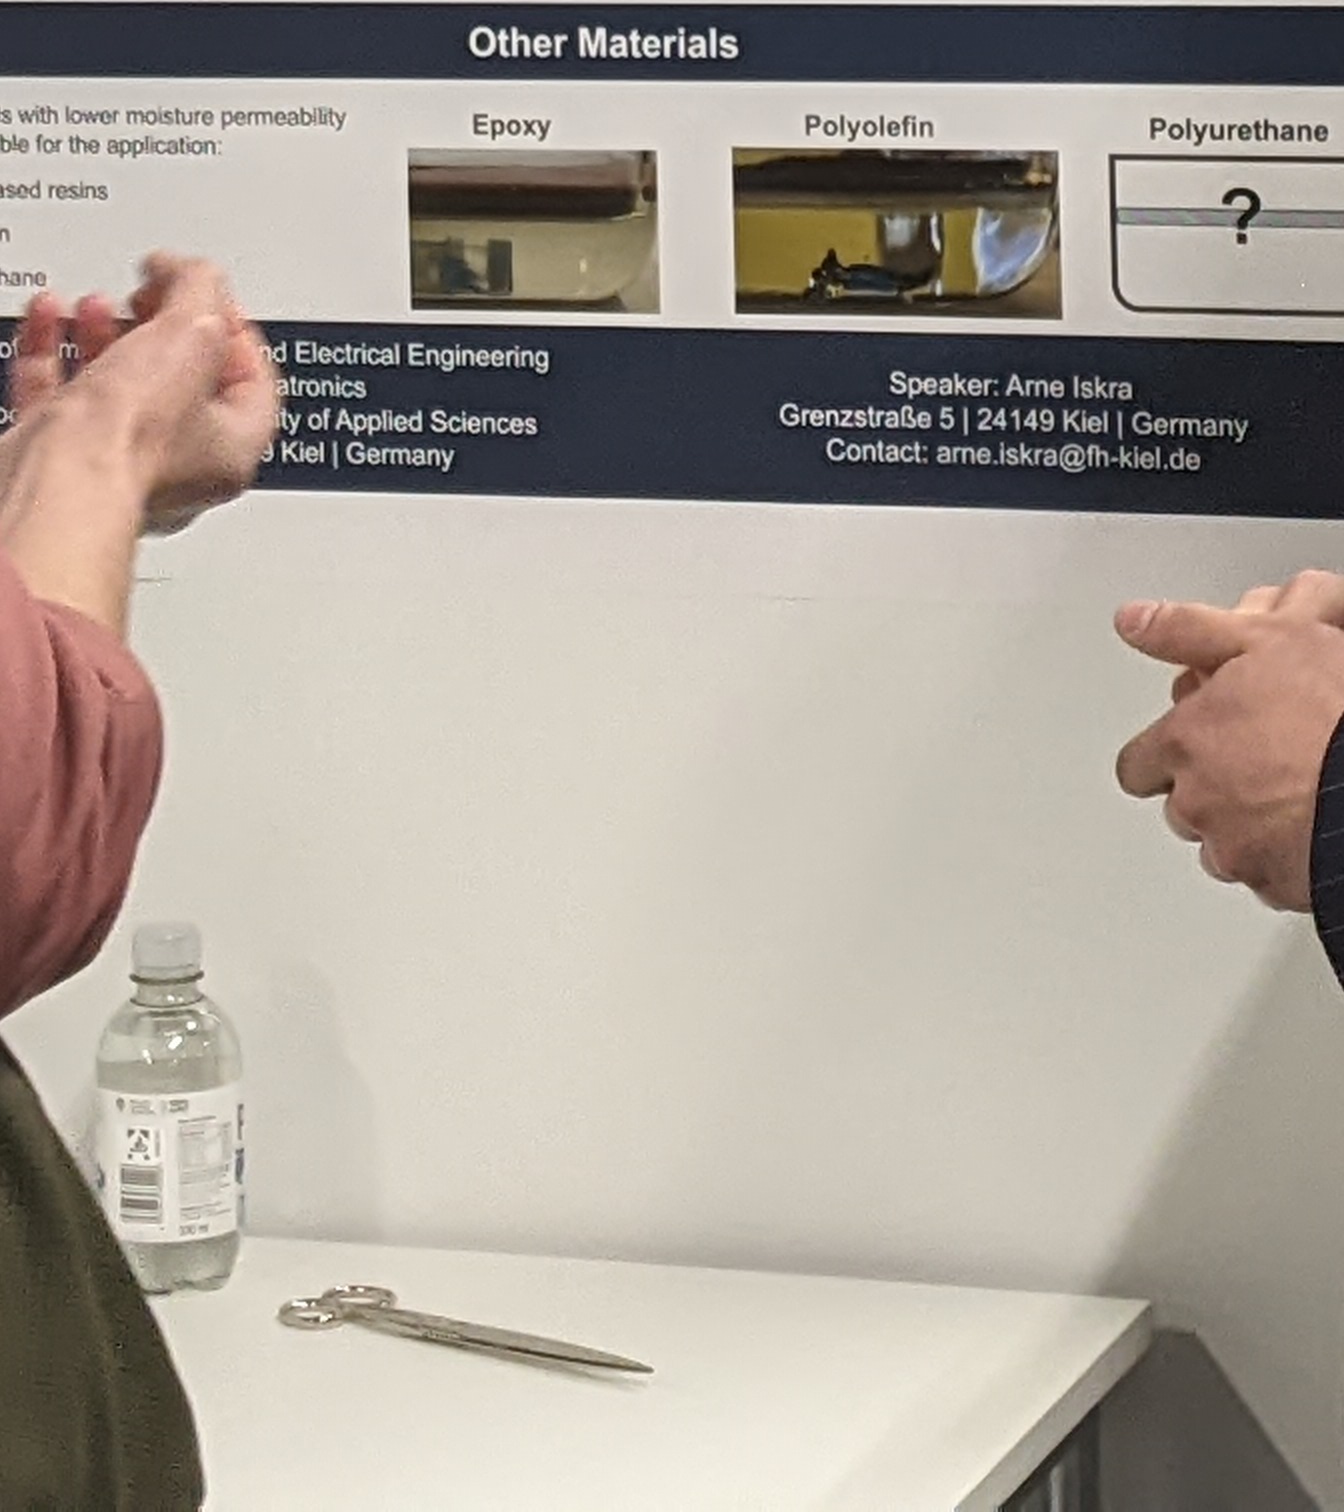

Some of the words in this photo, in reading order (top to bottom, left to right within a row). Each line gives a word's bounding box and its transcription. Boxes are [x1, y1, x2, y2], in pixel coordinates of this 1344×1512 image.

[468, 25, 568, 59] Other
[579, 25, 739, 60] Materials
[472, 112, 552, 143] Epoxy
[804, 113, 934, 143] Polyolefin
[1149, 116, 1329, 147] Polyurethane
[48, 180, 109, 202] resins
[258, 336, 287, 370] nd
[295, 339, 400, 367] Electrical
[408, 341, 549, 375] Engineering
[276, 371, 367, 404] atronics
[889, 369, 998, 400] Speaker:
[1005, 372, 1065, 399] Arne
[1073, 374, 1133, 402] Iskra
[307, 406, 331, 432] of
[335, 407, 423, 437] Applied
[431, 408, 538, 436] Sciences
[779, 402, 932, 430] Grenzstraße
[940, 405, 955, 431] 5
[977, 406, 1055, 434] 24149
[1063, 408, 1108, 435] Kiel
[1132, 409, 1249, 443] Germany
[281, 439, 325, 465] Kiel
[346, 439, 455, 474] Germany
[825, 436, 927, 465] Contact:
[936, 440, 1201, 473] arne.iskra@fh-kiel.de
